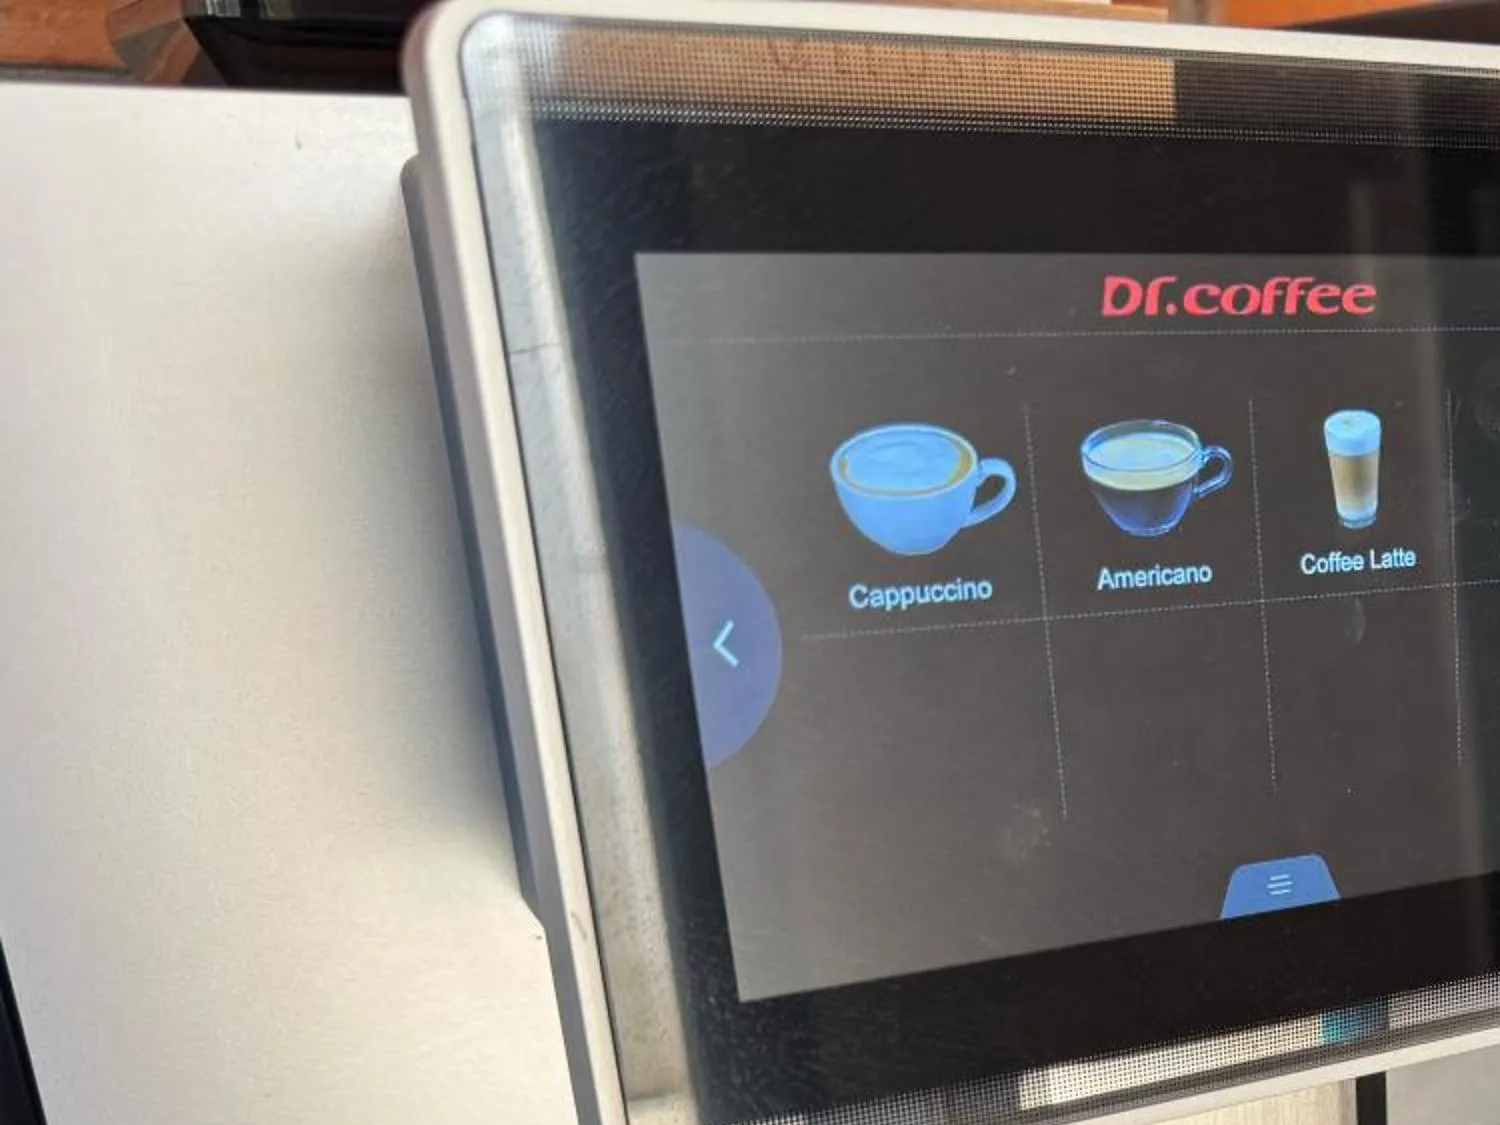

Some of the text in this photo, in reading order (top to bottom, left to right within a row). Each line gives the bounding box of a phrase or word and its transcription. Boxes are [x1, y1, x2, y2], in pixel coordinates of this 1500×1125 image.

[1101, 276, 1377, 317] Dr.coffee
[1098, 563, 1212, 590] Americano
[1301, 548, 1416, 575] Coffee Latte
[848, 576, 993, 611] Cappuccino
